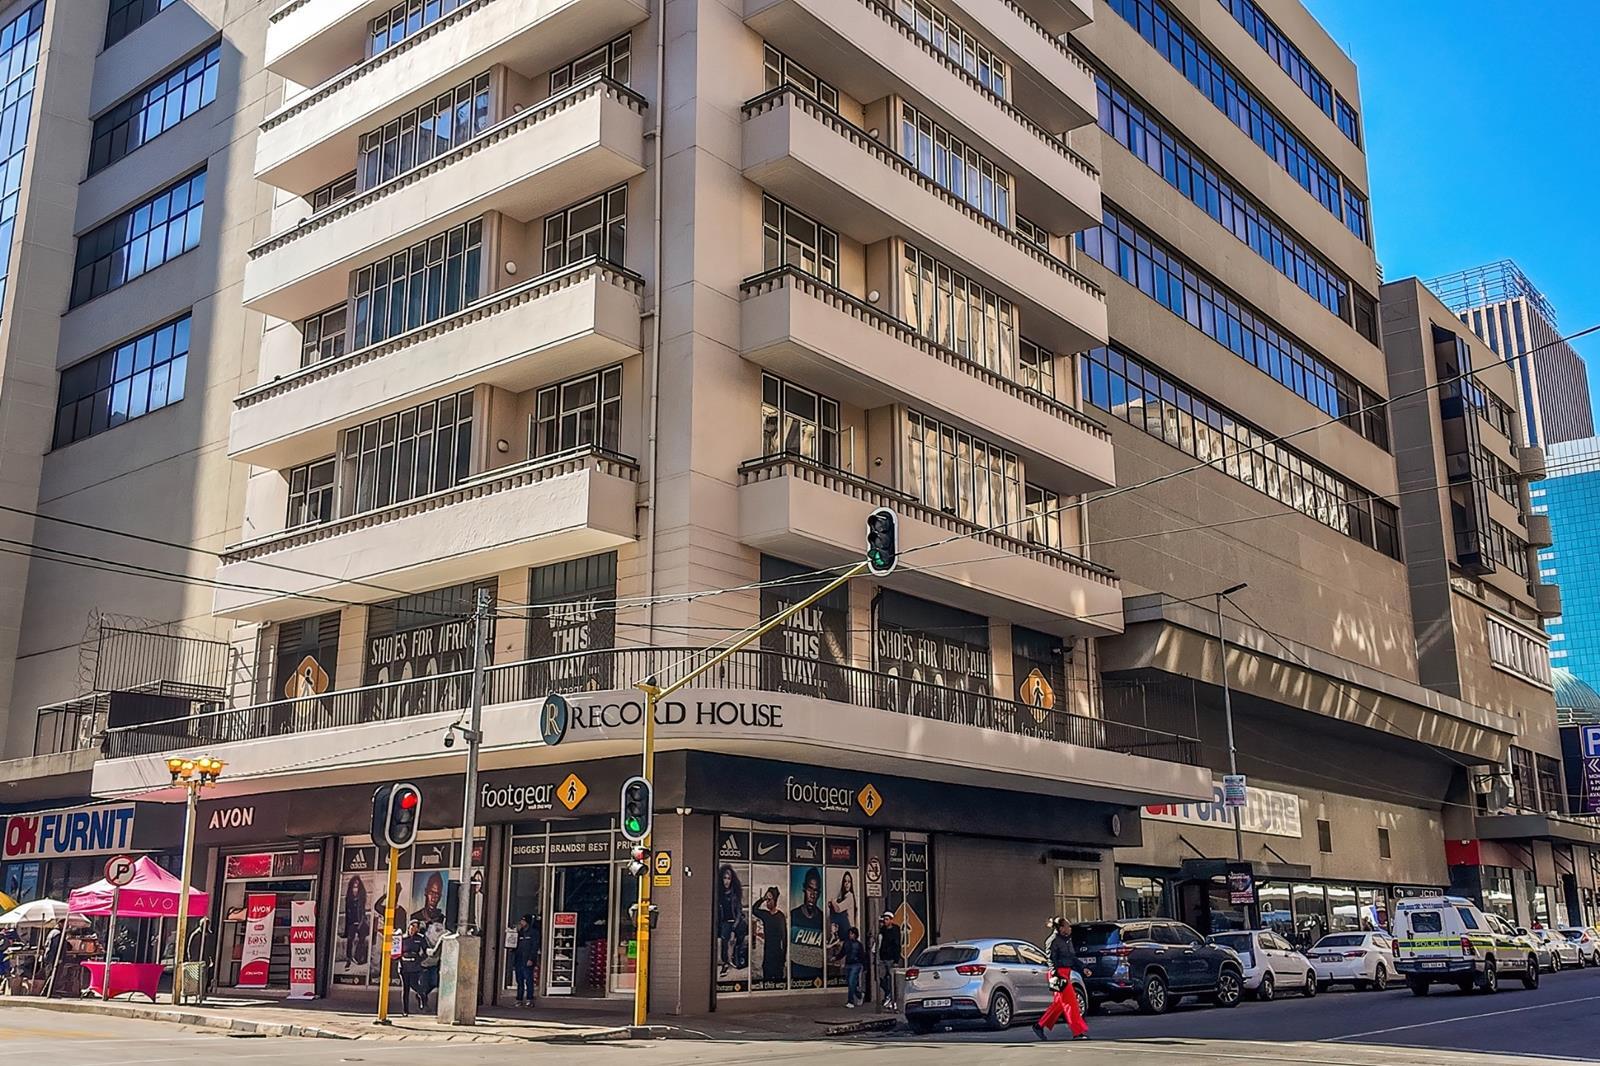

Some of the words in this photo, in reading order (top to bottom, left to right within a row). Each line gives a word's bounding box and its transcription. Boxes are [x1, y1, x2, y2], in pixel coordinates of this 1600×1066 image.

[371, 633, 407, 665] SHOES
[412, 628, 433, 658] FOR
[552, 625, 591, 655] THIS
[783, 630, 820, 660] THIS
[880, 628, 913, 663] SHOES
[918, 638, 938, 668] FOR
[544, 703, 561, 738] R
[696, 701, 783, 728] HOUSE
[481, 783, 554, 812] footgear
[786, 776, 855, 811] footgear
[6, 816, 39, 856] OK
[39, 808, 134, 853] FURNIT
[209, 807, 254, 829] AVON
[513, 845, 545, 855] BIGGEST
[588, 842, 608, 852] BEST
[252, 905, 271, 913] AVON
[293, 930, 314, 939] AVON
[795, 929, 823, 946] PUMA
[294, 969, 312, 980] FREE
